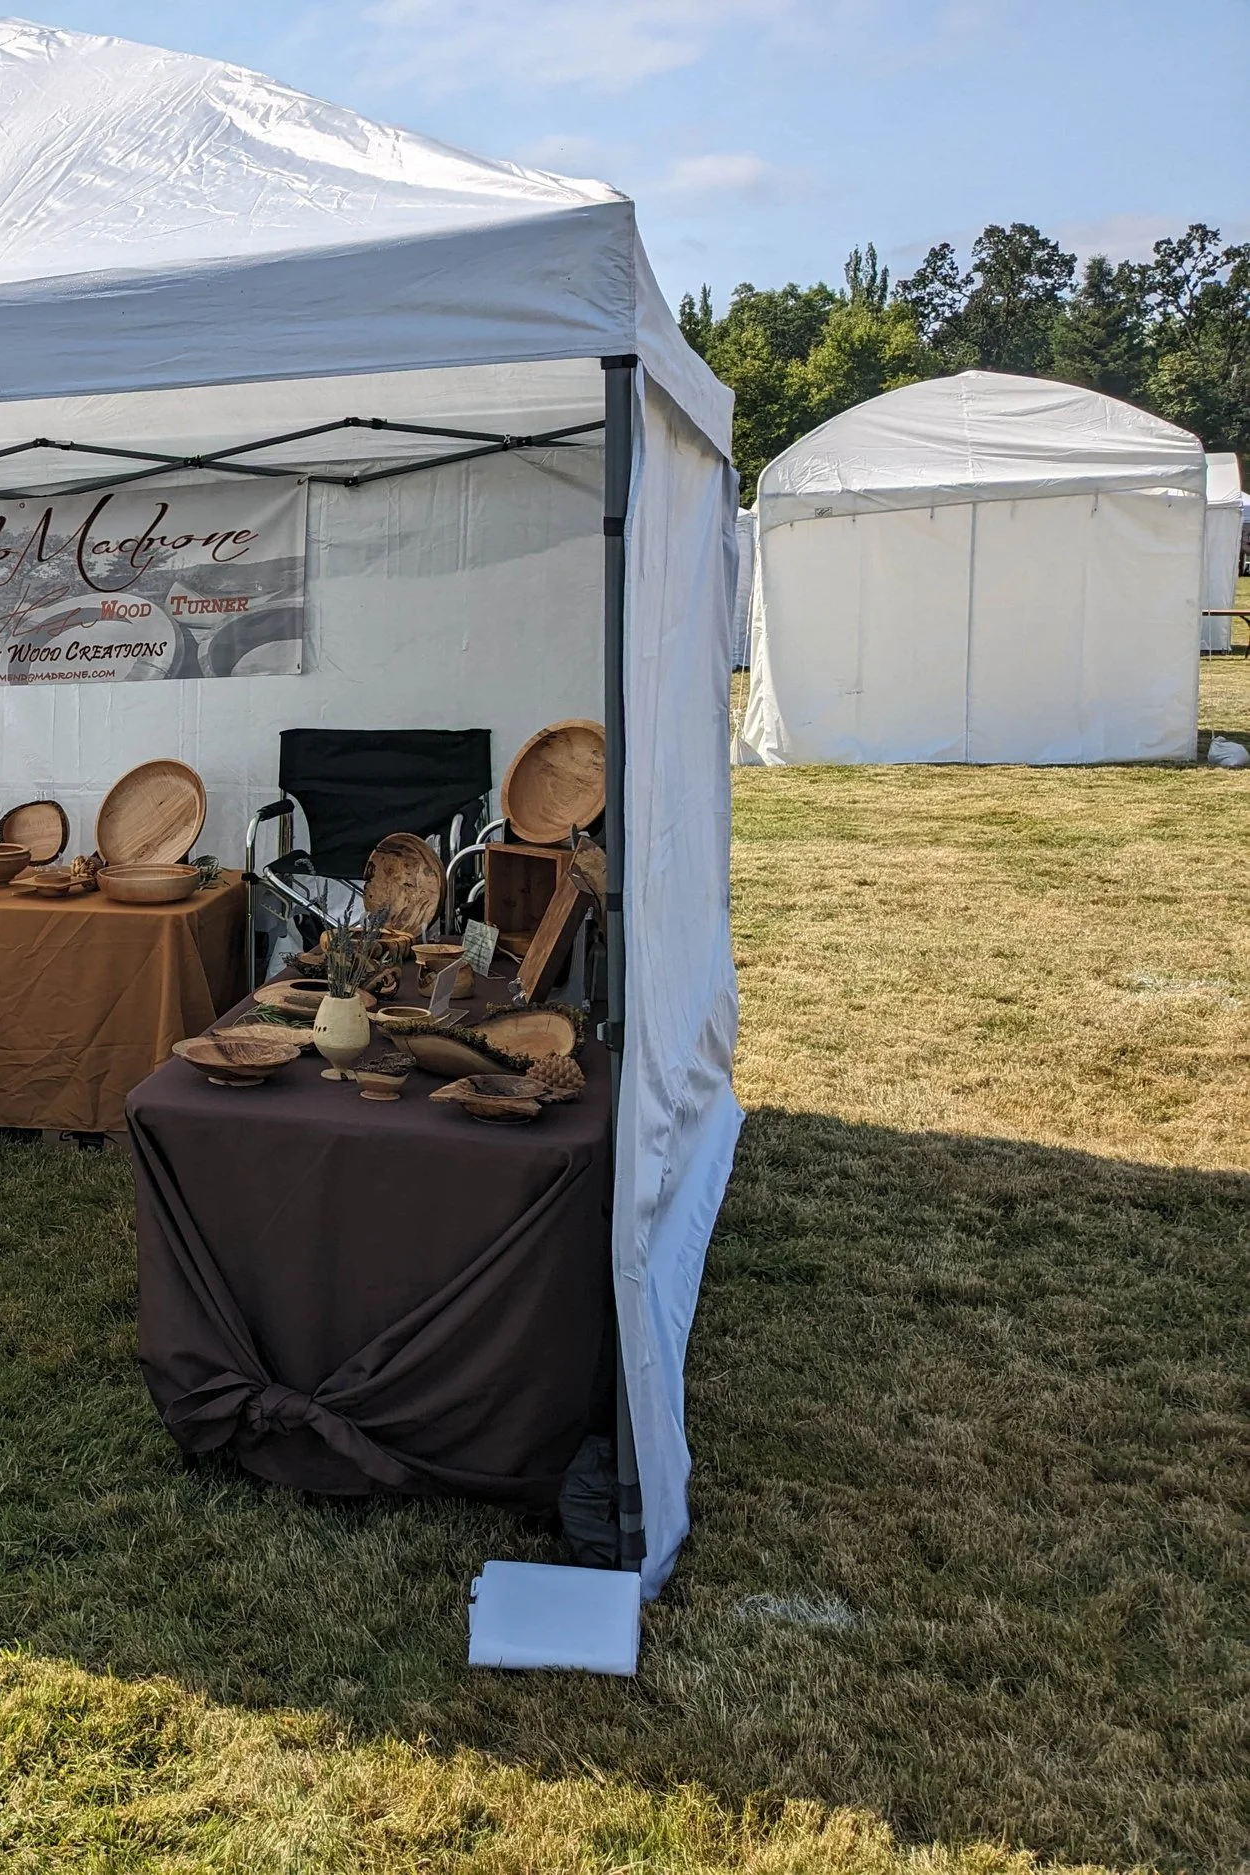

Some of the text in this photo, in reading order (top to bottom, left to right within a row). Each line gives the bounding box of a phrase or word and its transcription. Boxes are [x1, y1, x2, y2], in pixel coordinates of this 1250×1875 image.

[100, 600, 152, 620] WOOD
[170, 595, 249, 616] TURNER
[7, 642, 62, 663] WOOD
[65, 641, 168, 662] CREATIONS
